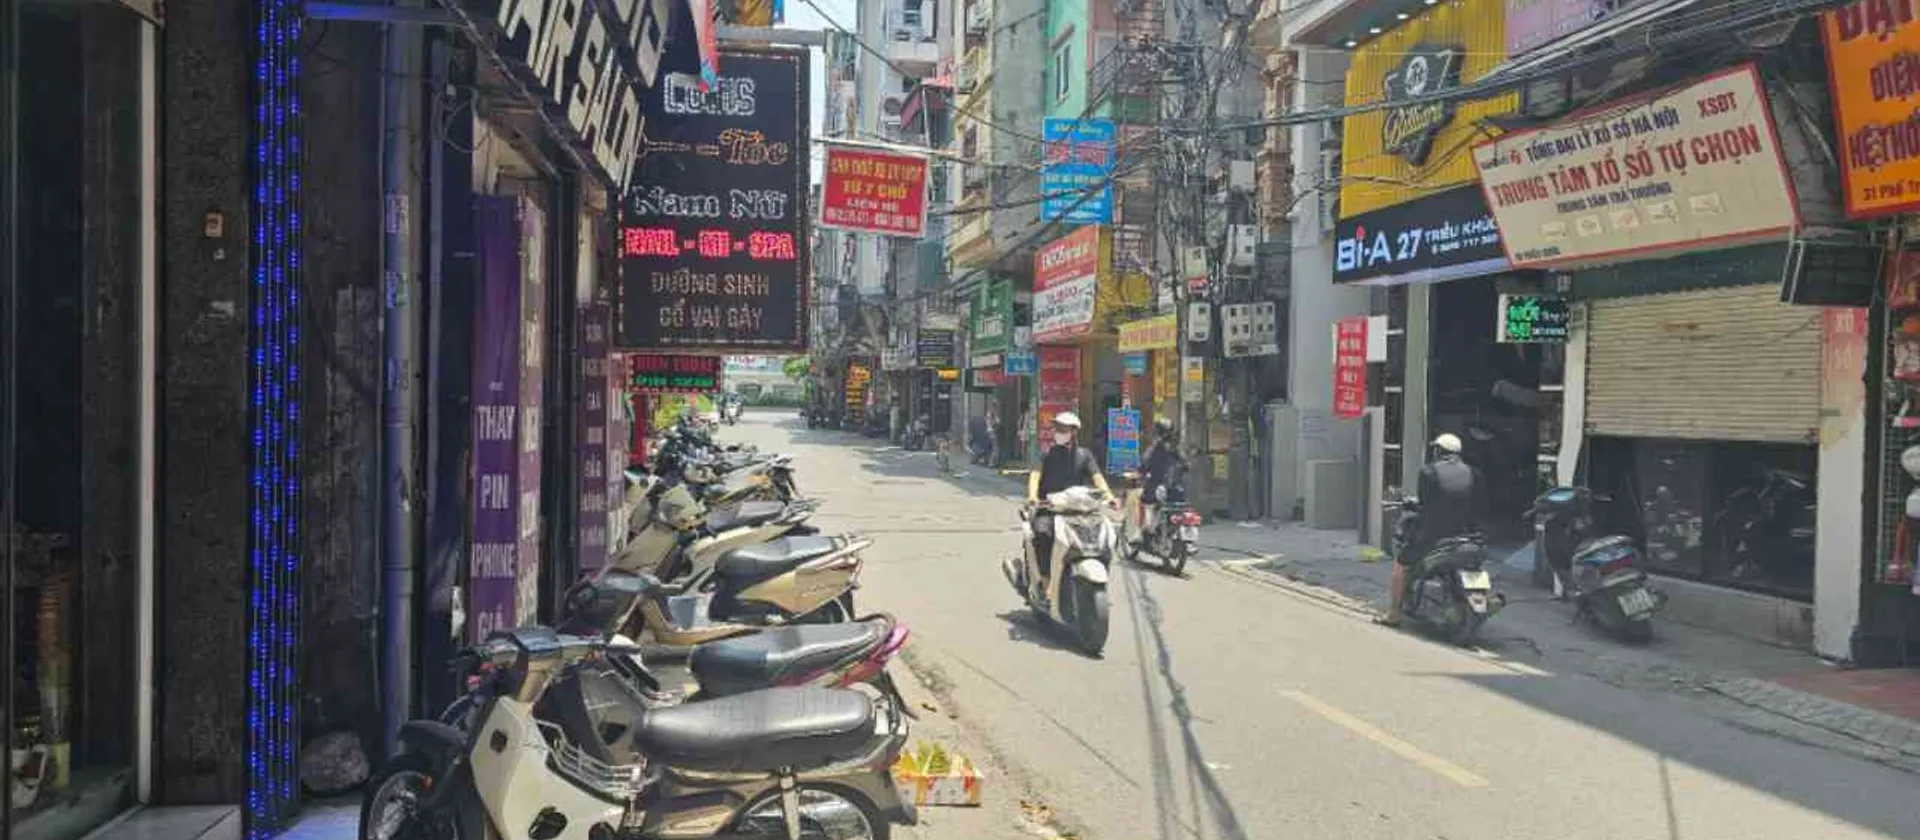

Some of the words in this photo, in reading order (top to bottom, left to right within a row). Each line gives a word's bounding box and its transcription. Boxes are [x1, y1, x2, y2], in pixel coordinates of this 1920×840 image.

[1492, 173, 1549, 207] TRUNG
[1549, 162, 1592, 196] TÂM
[1594, 148, 1622, 187] XỔ
[1624, 138, 1654, 179] SỐ
[1656, 138, 1688, 177] TỰ
[1694, 122, 1763, 166] CHỌN
[750, 231, 796, 260] SPA
[1396, 228, 1424, 261] 27
[724, 272, 771, 297] SINH
[477, 404, 517, 441] THAY
[480, 473, 509, 510] PIN
[470, 543, 516, 578] IPHONE
